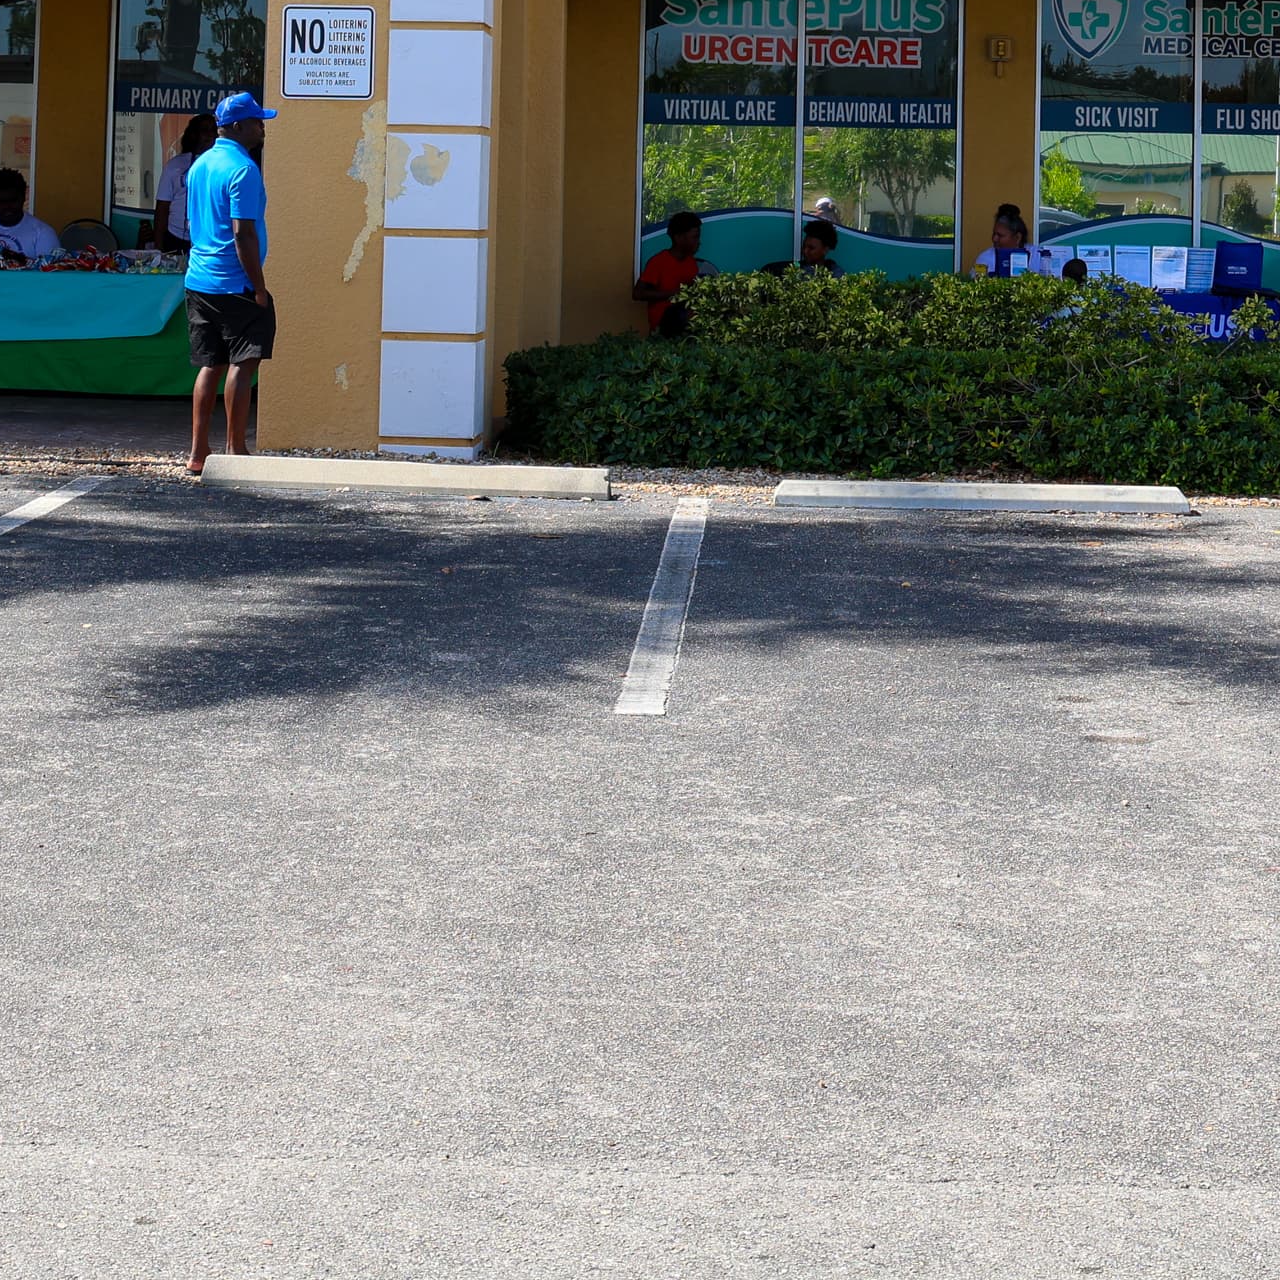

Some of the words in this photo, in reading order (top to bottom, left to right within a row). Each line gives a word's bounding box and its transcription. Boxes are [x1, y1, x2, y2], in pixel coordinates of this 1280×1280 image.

[328, 19, 368, 30] LOITERING
[290, 19, 325, 54] NO
[328, 32, 366, 42] LITTERING
[328, 45, 365, 54] DRINKING
[289, 57, 297, 66] OF
[299, 58, 332, 66] ALCOHOLIC
[333, 58, 367, 67] BEVERAGES
[305, 71, 336, 79] VIOLATORS
[338, 71, 350, 79] ARE
[325, 79, 333, 87] TO
[334, 79, 356, 87] ARREST
[131, 87, 201, 110] PRIMARY
[663, 99, 730, 120] VIRTUAL
[735, 100, 776, 121] CARE
[809, 101, 895, 123] BEHAVIORAL
[900, 103, 951, 124] HEALTH
[1075, 106, 1111, 127] SICK
[1116, 107, 1159, 128] VISIT
[1216, 108, 1245, 130] FLU
